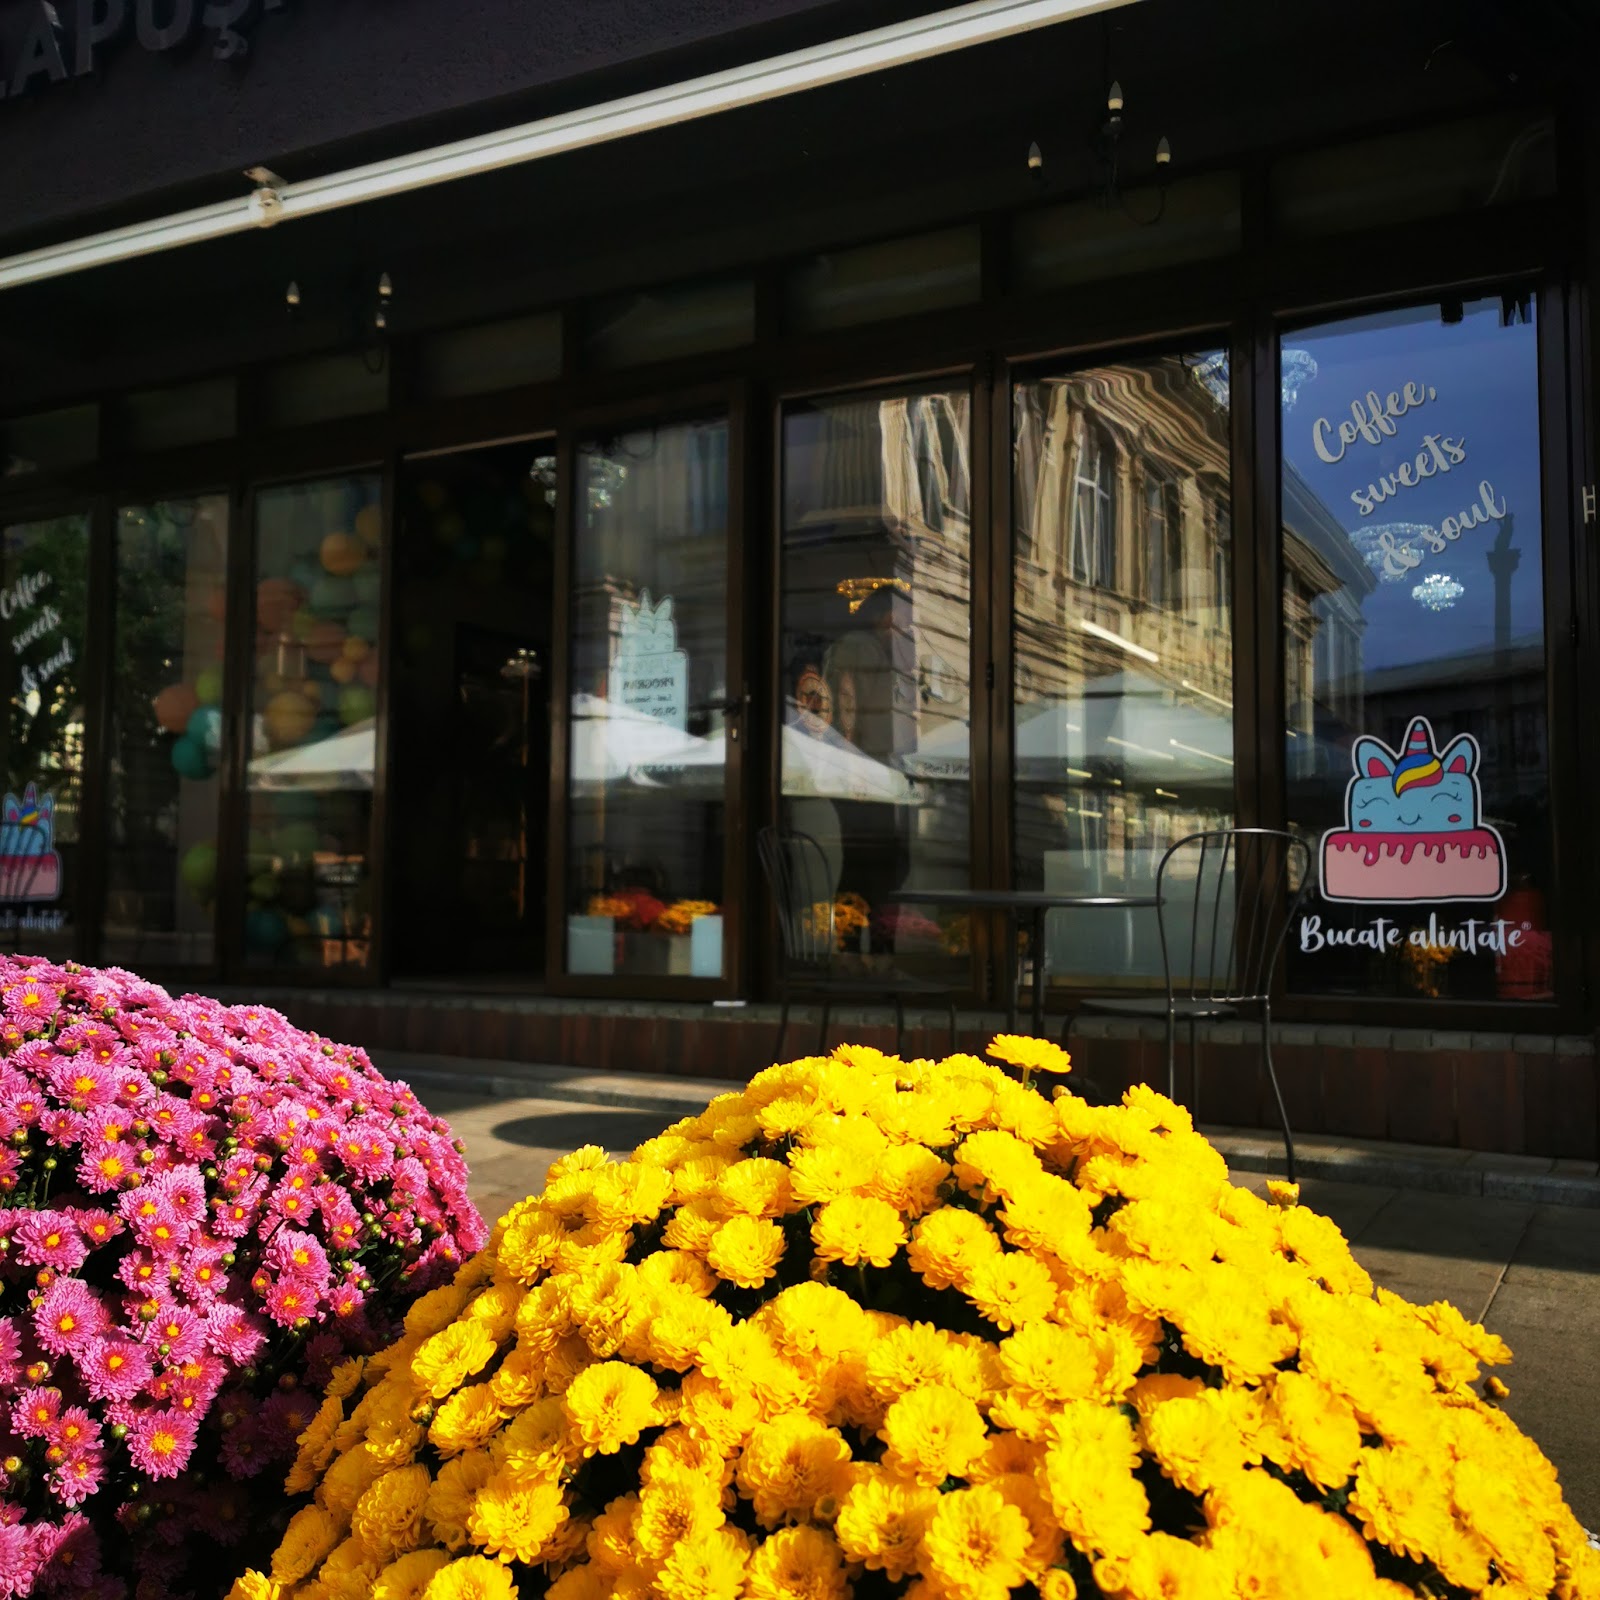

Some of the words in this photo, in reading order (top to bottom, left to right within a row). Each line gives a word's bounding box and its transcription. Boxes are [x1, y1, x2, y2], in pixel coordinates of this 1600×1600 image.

[1312, 381, 1437, 463] Coffee,
[1350, 434, 1466, 516] sweets
[1379, 532, 1422, 575] &
[1422, 480, 1507, 553] soul
[1299, 914, 1403, 954] Bucate
